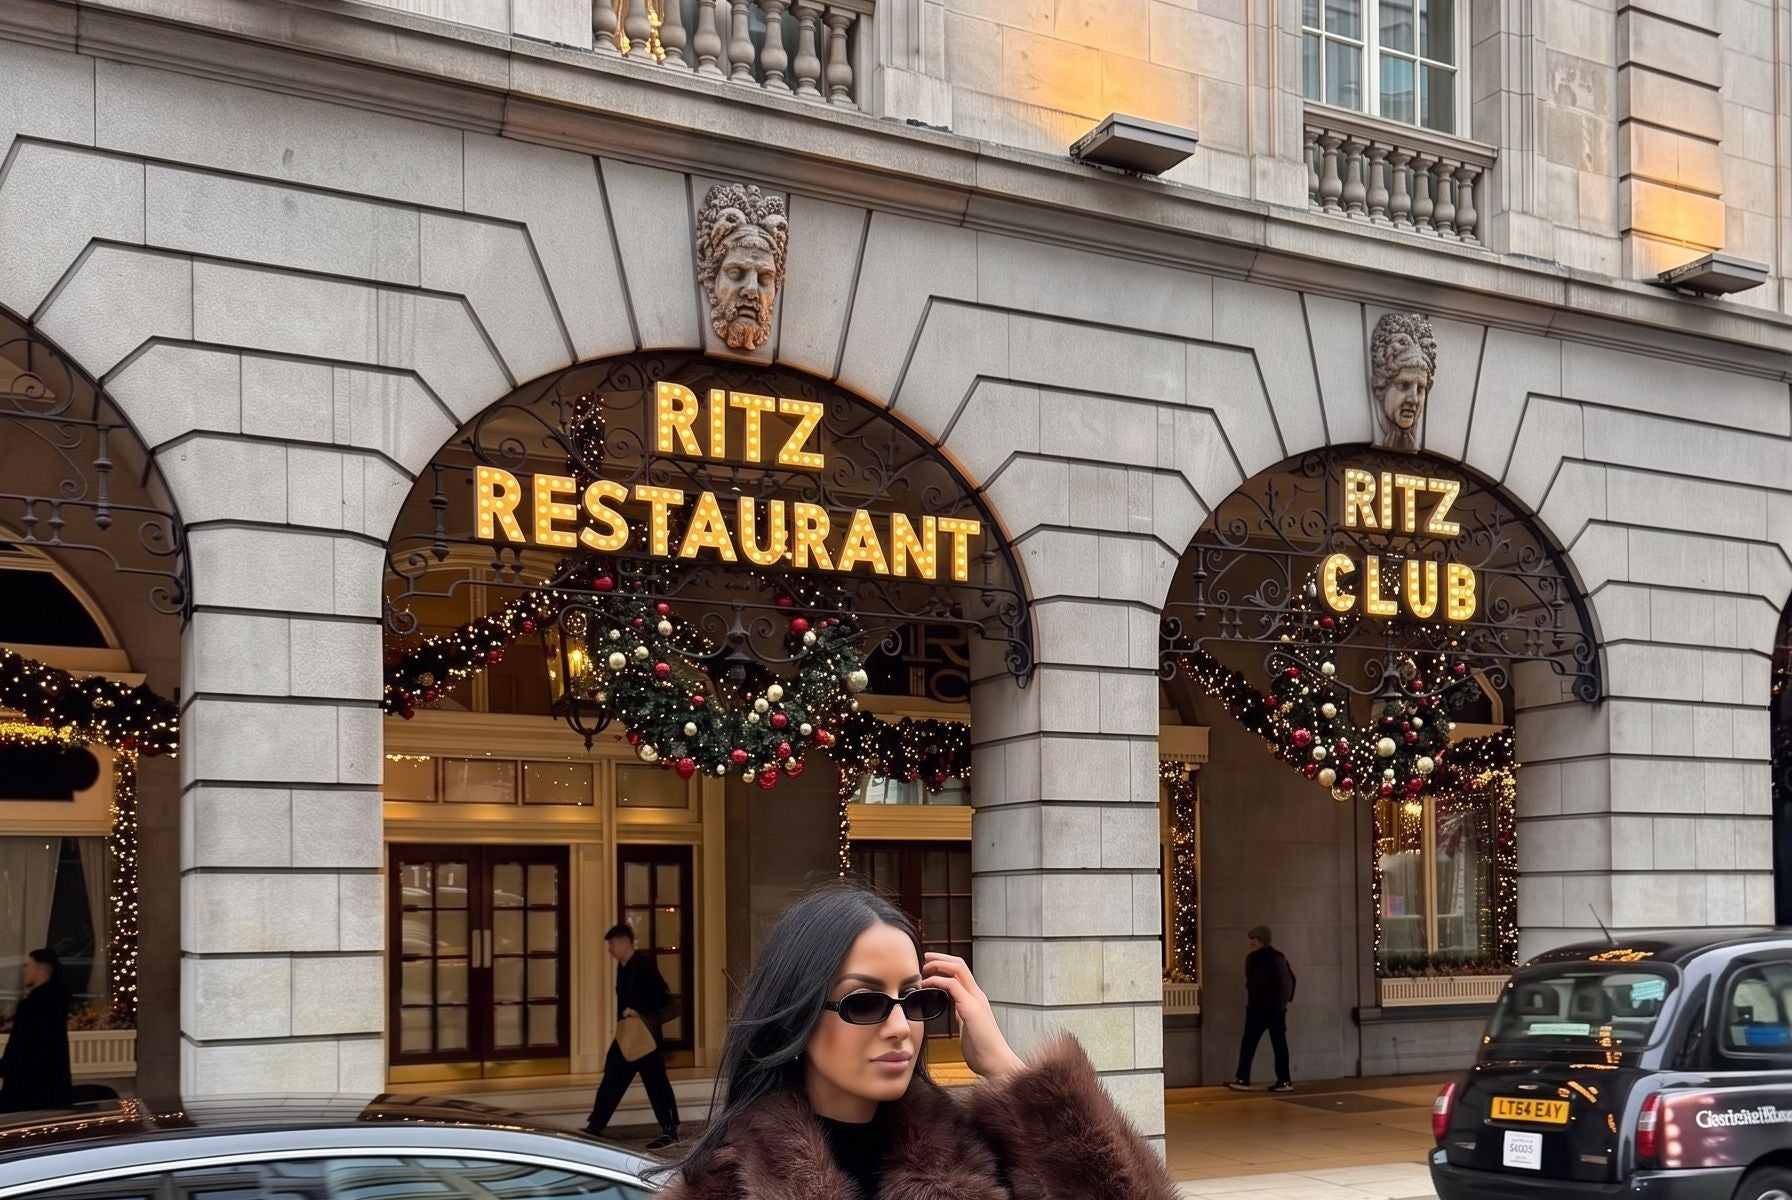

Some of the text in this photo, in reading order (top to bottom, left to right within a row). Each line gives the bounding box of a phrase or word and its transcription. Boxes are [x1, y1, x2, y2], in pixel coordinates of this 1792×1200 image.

[654, 380, 825, 469] RITZ
[474, 465, 981, 582] RESTAURANT
[1344, 468, 1461, 536] RITZ
[1321, 552, 1477, 621] CLUB
[1535, 1102, 1562, 1118] EAY
